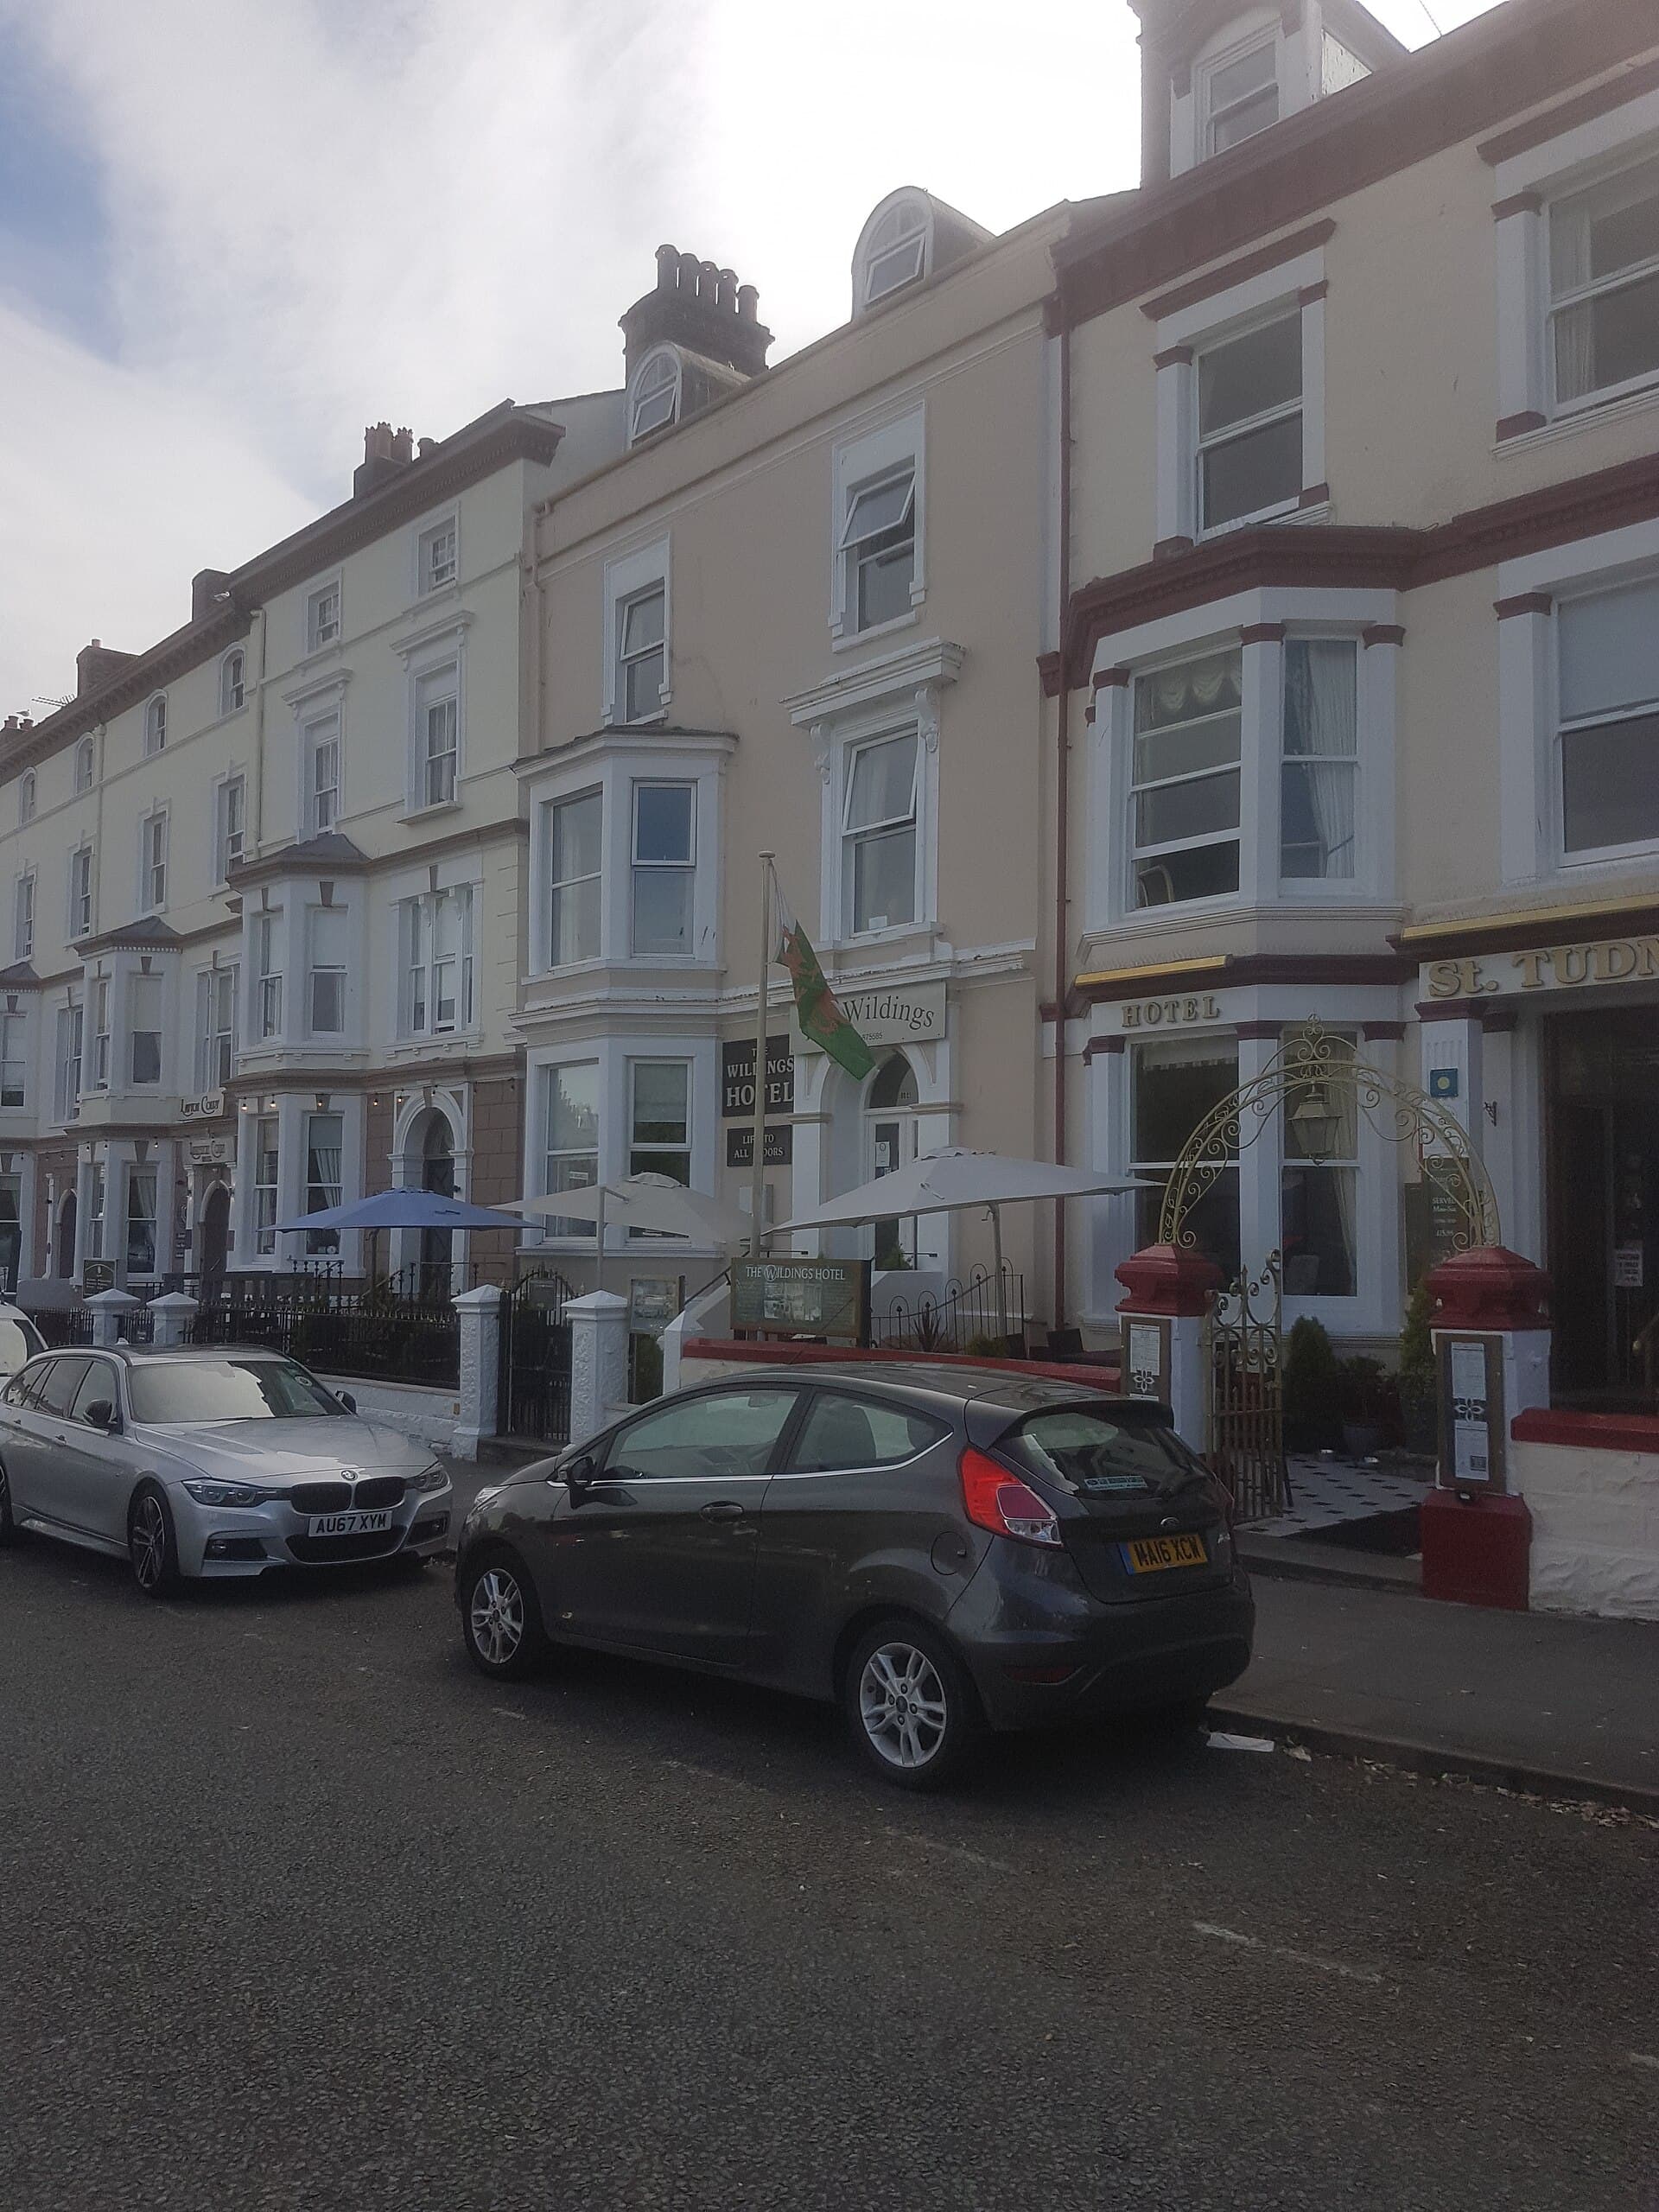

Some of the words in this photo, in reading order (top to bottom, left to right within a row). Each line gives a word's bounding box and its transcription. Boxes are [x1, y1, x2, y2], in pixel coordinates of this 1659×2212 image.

[1429, 959, 1499, 997] St.
[842, 995, 935, 1031] Wildings
[1122, 995, 1220, 1027] HOTEL
[727, 1057, 794, 1078] WILNGS
[726, 1081, 794, 1107] HOEL
[742, 1135, 757, 1145] LIF
[734, 1148, 749, 1159] ALL
[746, 1266, 762, 1278] THE
[764, 1264, 813, 1282] WILDINGS
[815, 1268, 846, 1281] HOTEL
[315, 1516, 357, 1534] AU67
[359, 1513, 386, 1530] XYM
